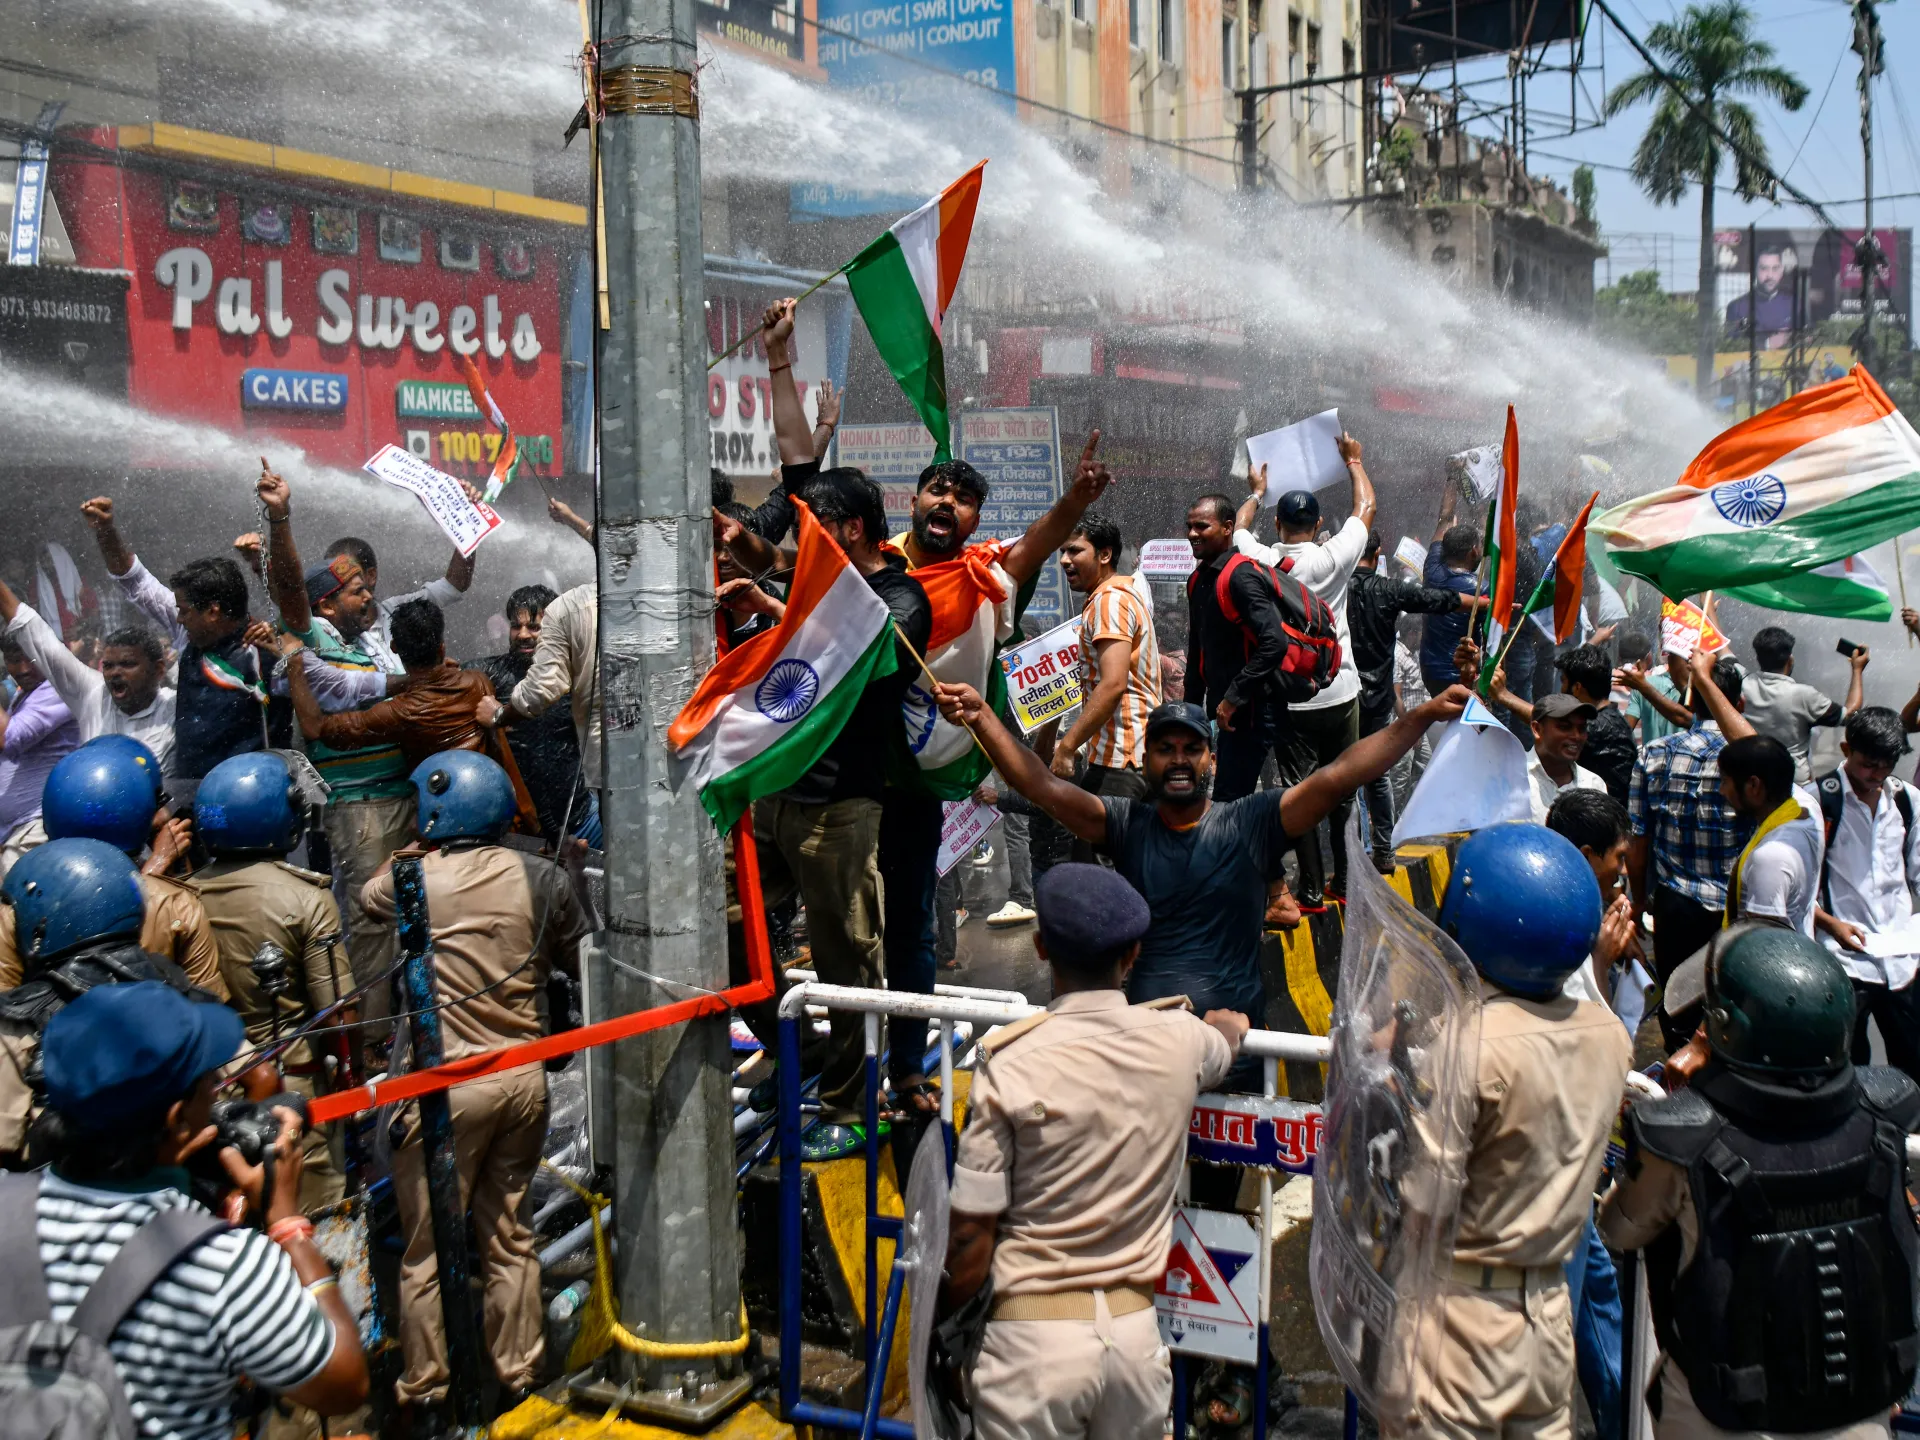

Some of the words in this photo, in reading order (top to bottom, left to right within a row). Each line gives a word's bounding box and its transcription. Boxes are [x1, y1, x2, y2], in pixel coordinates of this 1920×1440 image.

[862, 5, 901, 29] CPVC
[912, 0, 948, 22] SWR
[927, 17, 1001, 46] CONDUIT
[33, 299, 111, 323] 9334083872
[155, 247, 293, 338] Pal
[317, 268, 542, 361] Sweets
[253, 375, 341, 405] CAKES
[840, 428, 881, 447] MONIKA
[1011, 652, 1057, 690] 70वीं
[1056, 643, 1080, 668] BP
[1017, 680, 1053, 706] परीक्षा
[1051, 672, 1069, 689] को
[1027, 695, 1066, 721] निरस्त
[1168, 1298, 1189, 1310] पटना
[1168, 1312, 1183, 1330] हेतु
[1187, 1315, 1218, 1334] सेवारत
